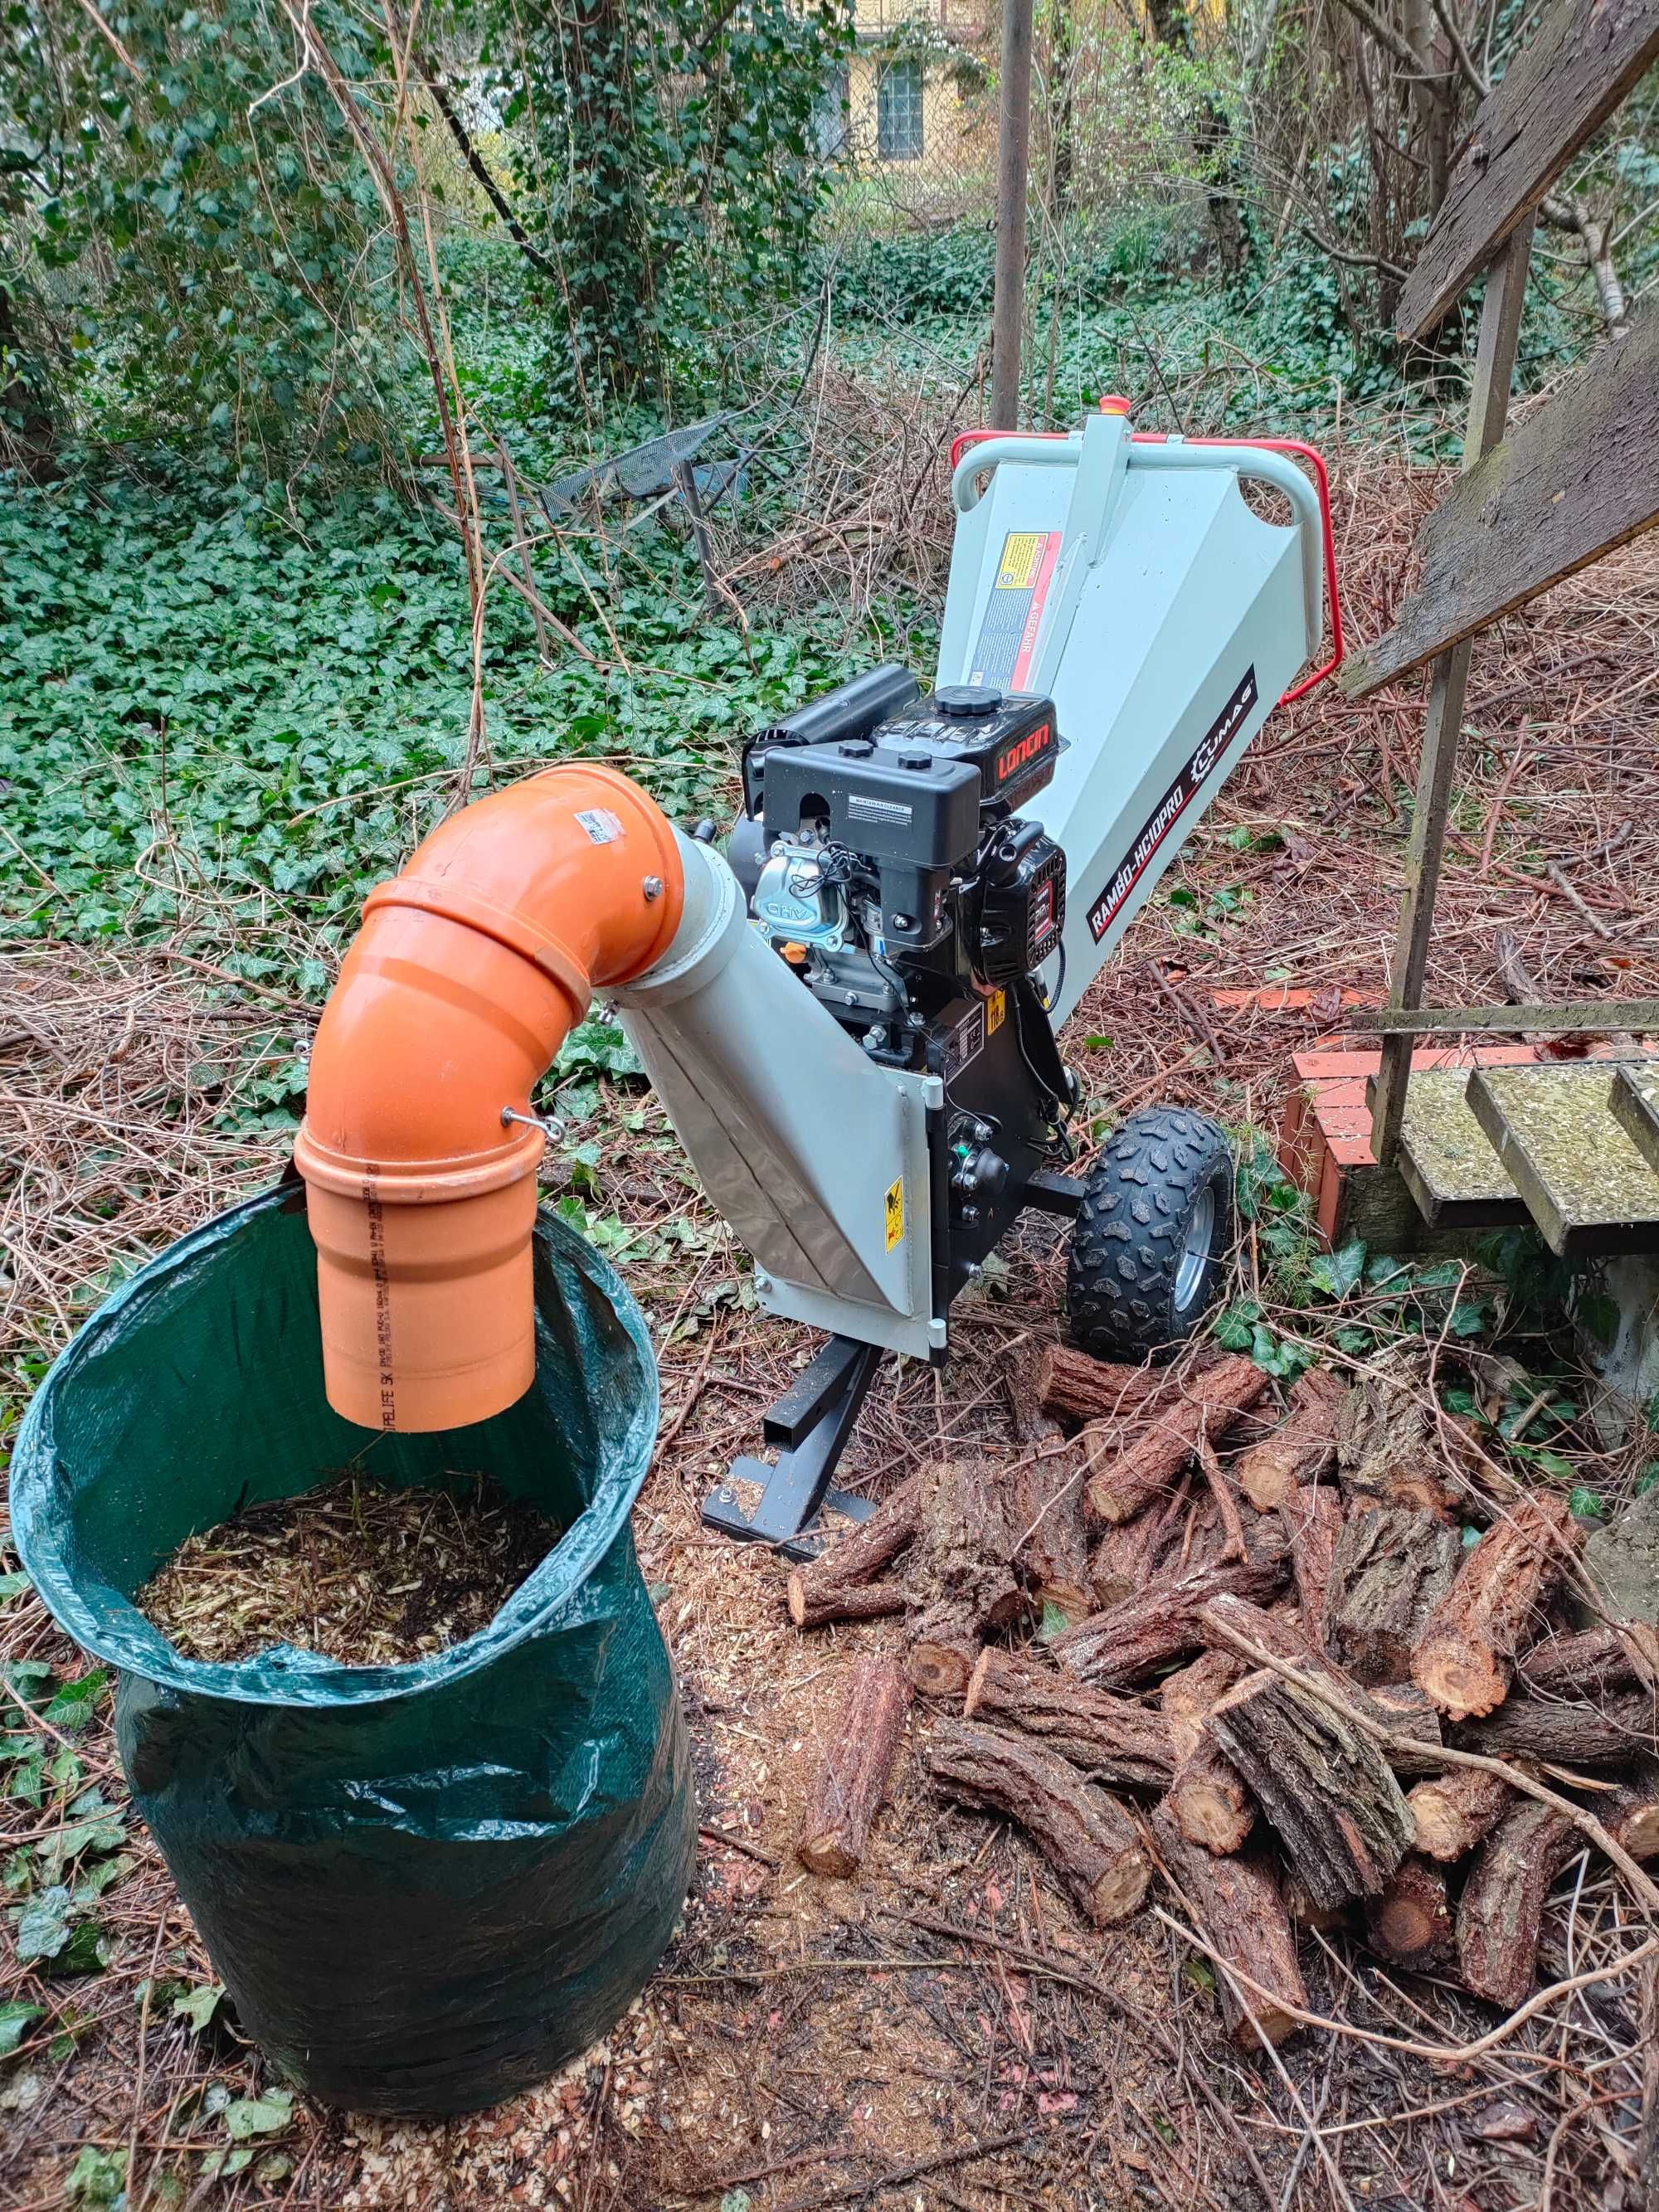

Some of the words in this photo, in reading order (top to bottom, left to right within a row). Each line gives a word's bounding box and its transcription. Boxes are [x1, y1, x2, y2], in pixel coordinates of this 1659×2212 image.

[1029, 548, 1043, 579] ACHTUNG
[1022, 612, 1041, 653] GEFAHR
[1198, 682, 1253, 769] LUMAG
[1092, 785, 1184, 932] RAMBO-HC10PRO
[766, 902, 807, 920] OHV
[380, 1373, 393, 1386] SK
